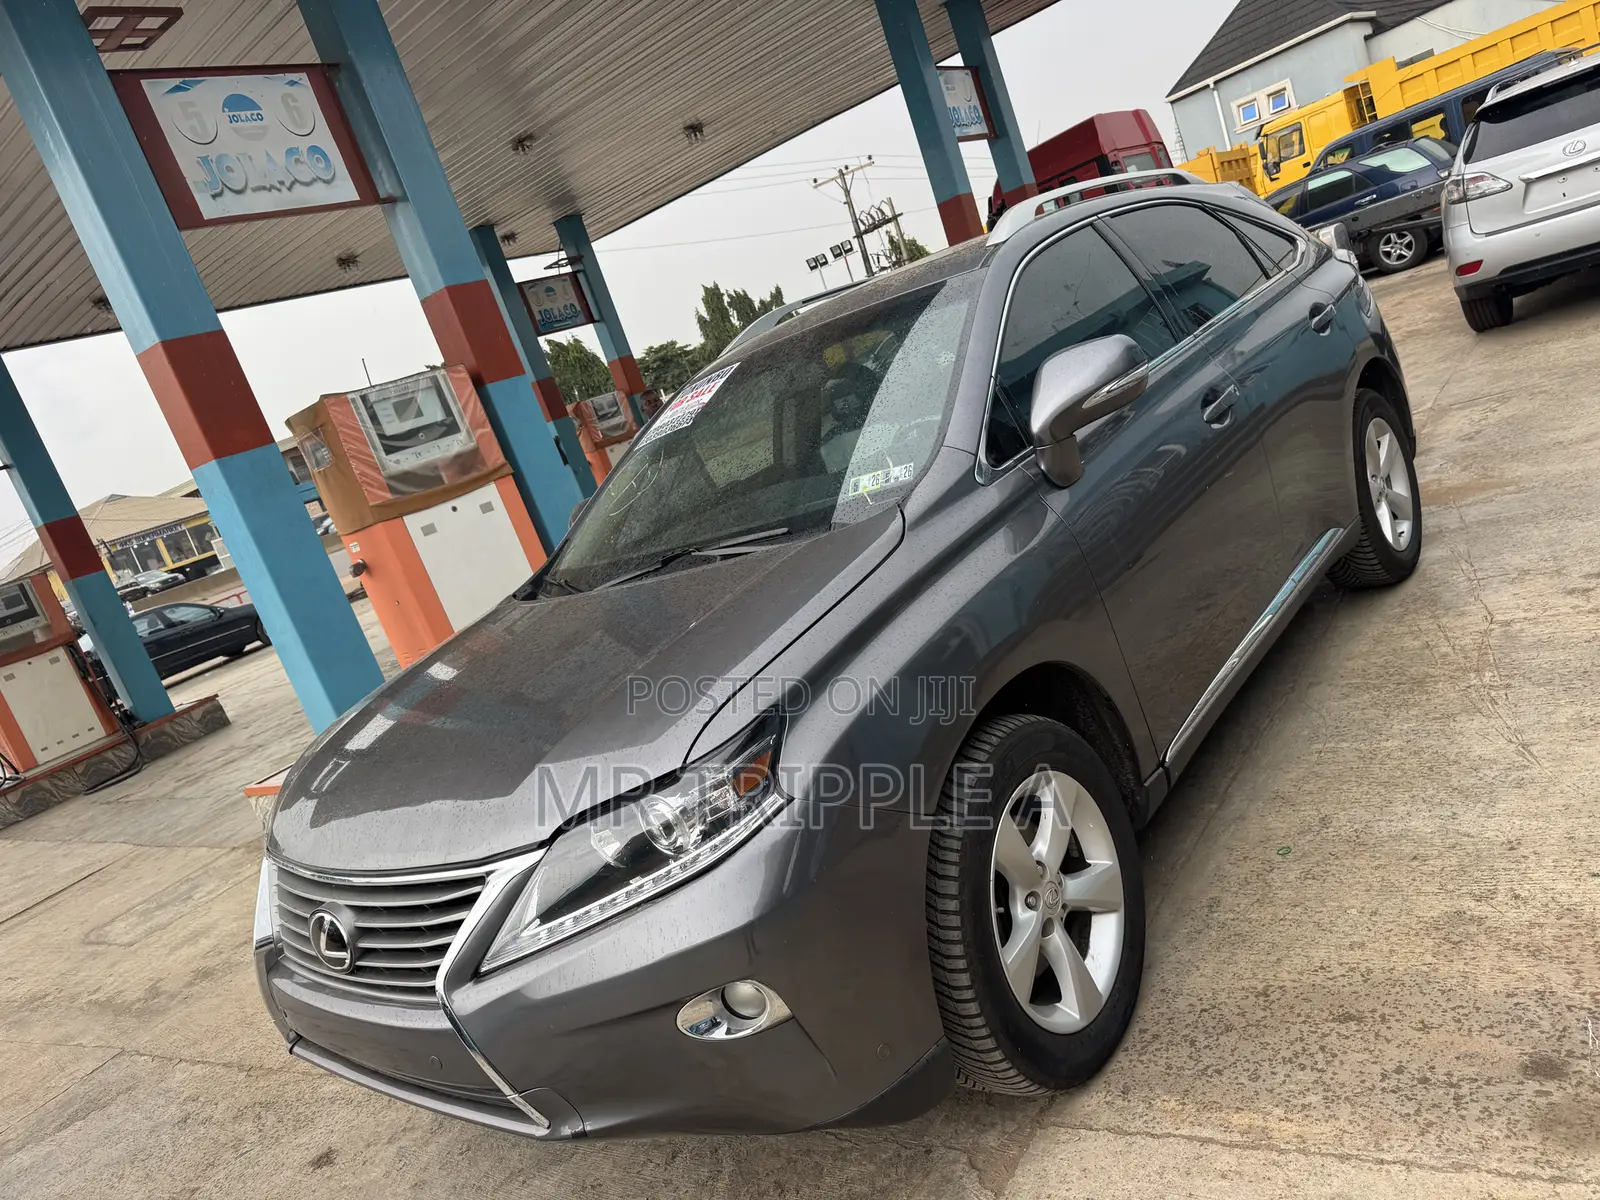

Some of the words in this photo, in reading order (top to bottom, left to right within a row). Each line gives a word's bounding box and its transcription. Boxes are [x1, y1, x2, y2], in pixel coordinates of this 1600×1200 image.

[228, 112, 264, 124] JOLACO
[280, 93, 307, 129] 6
[197, 144, 335, 198] JOLACO
[538, 302, 579, 325] JOLACO
[686, 380, 720, 403] SALE
[871, 473, 880, 487] 26
[903, 464, 913, 478] 26
[136, 523, 184, 543] SUPERMARKET
